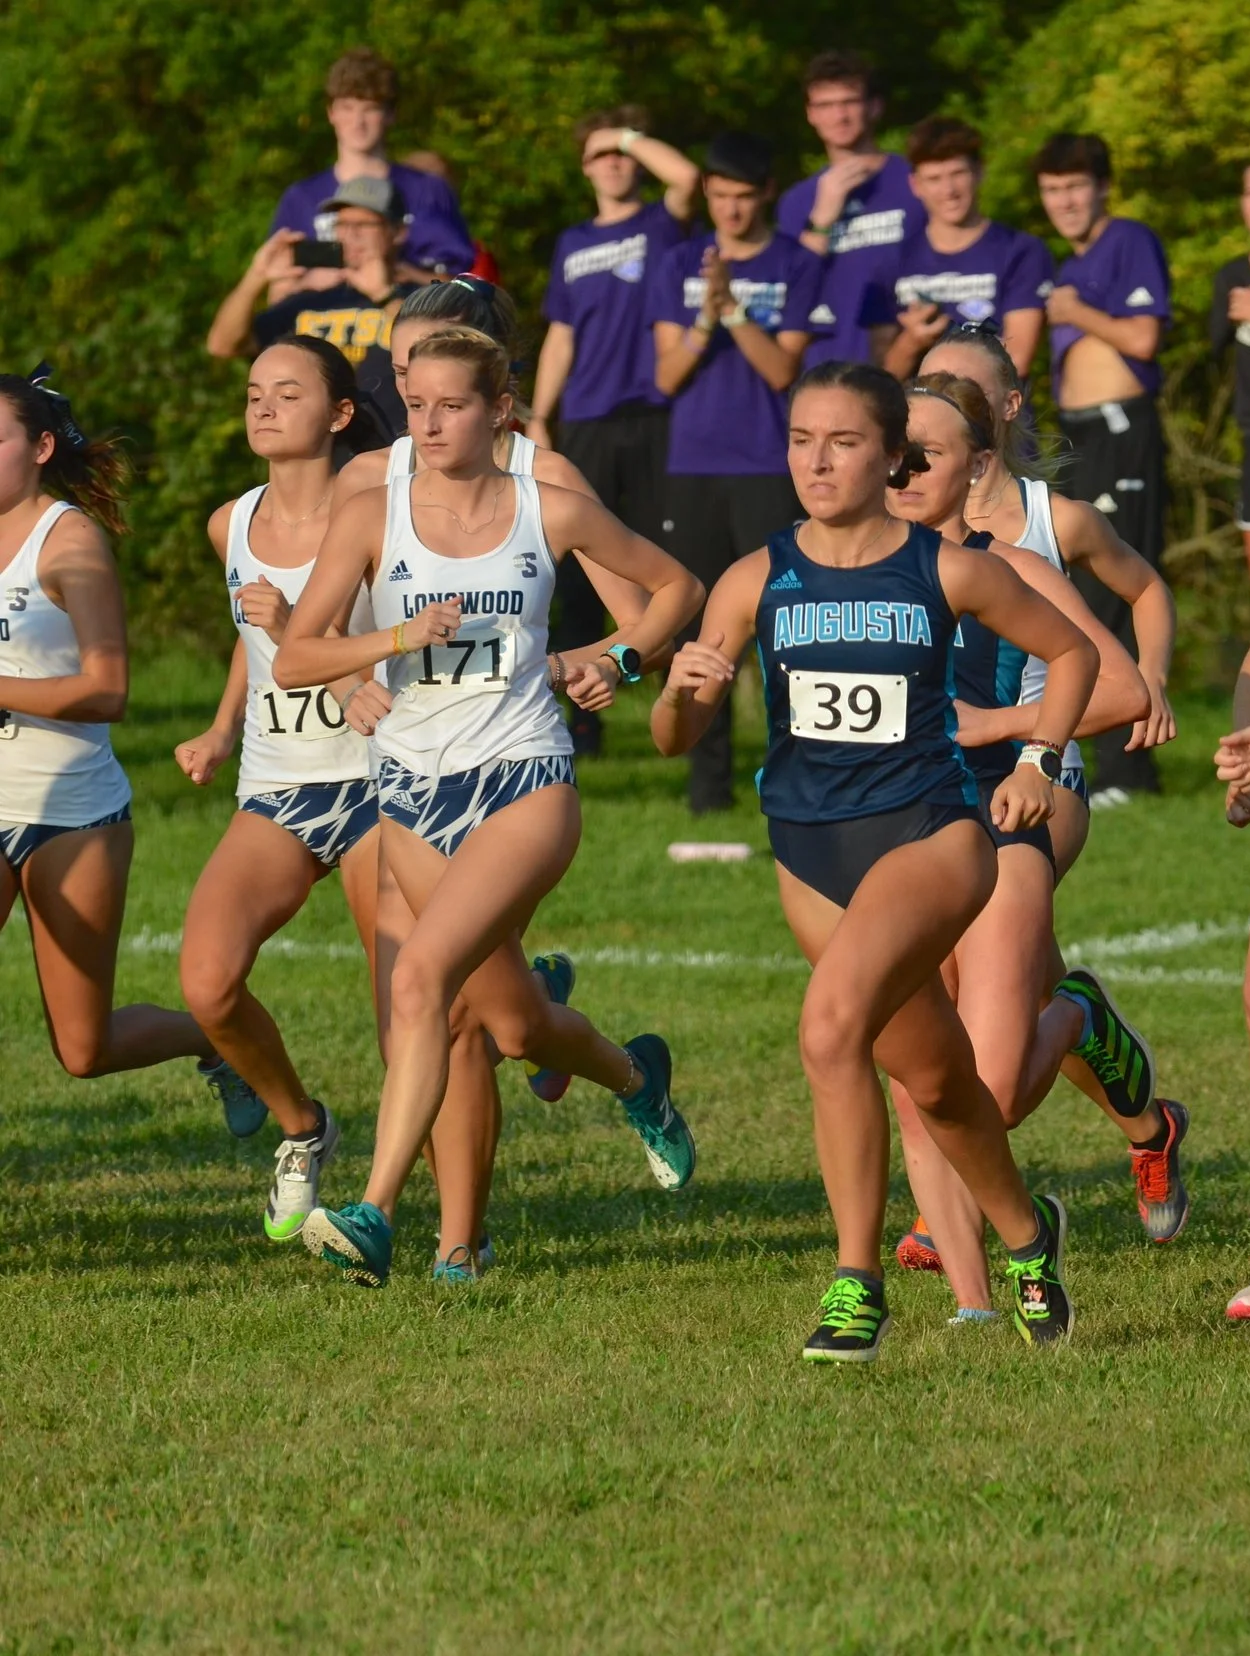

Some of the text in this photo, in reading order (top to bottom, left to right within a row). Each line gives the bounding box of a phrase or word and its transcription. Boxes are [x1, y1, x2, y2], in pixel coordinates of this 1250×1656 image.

[388, 573, 413, 582] adidas
[770, 580, 803, 590] adidas
[773, 601, 933, 652] AUGUSTA
[418, 637, 509, 685] 171
[263, 687, 346, 734] 170
[813, 682, 882, 733] 39
[389, 796, 420, 815] adidas
